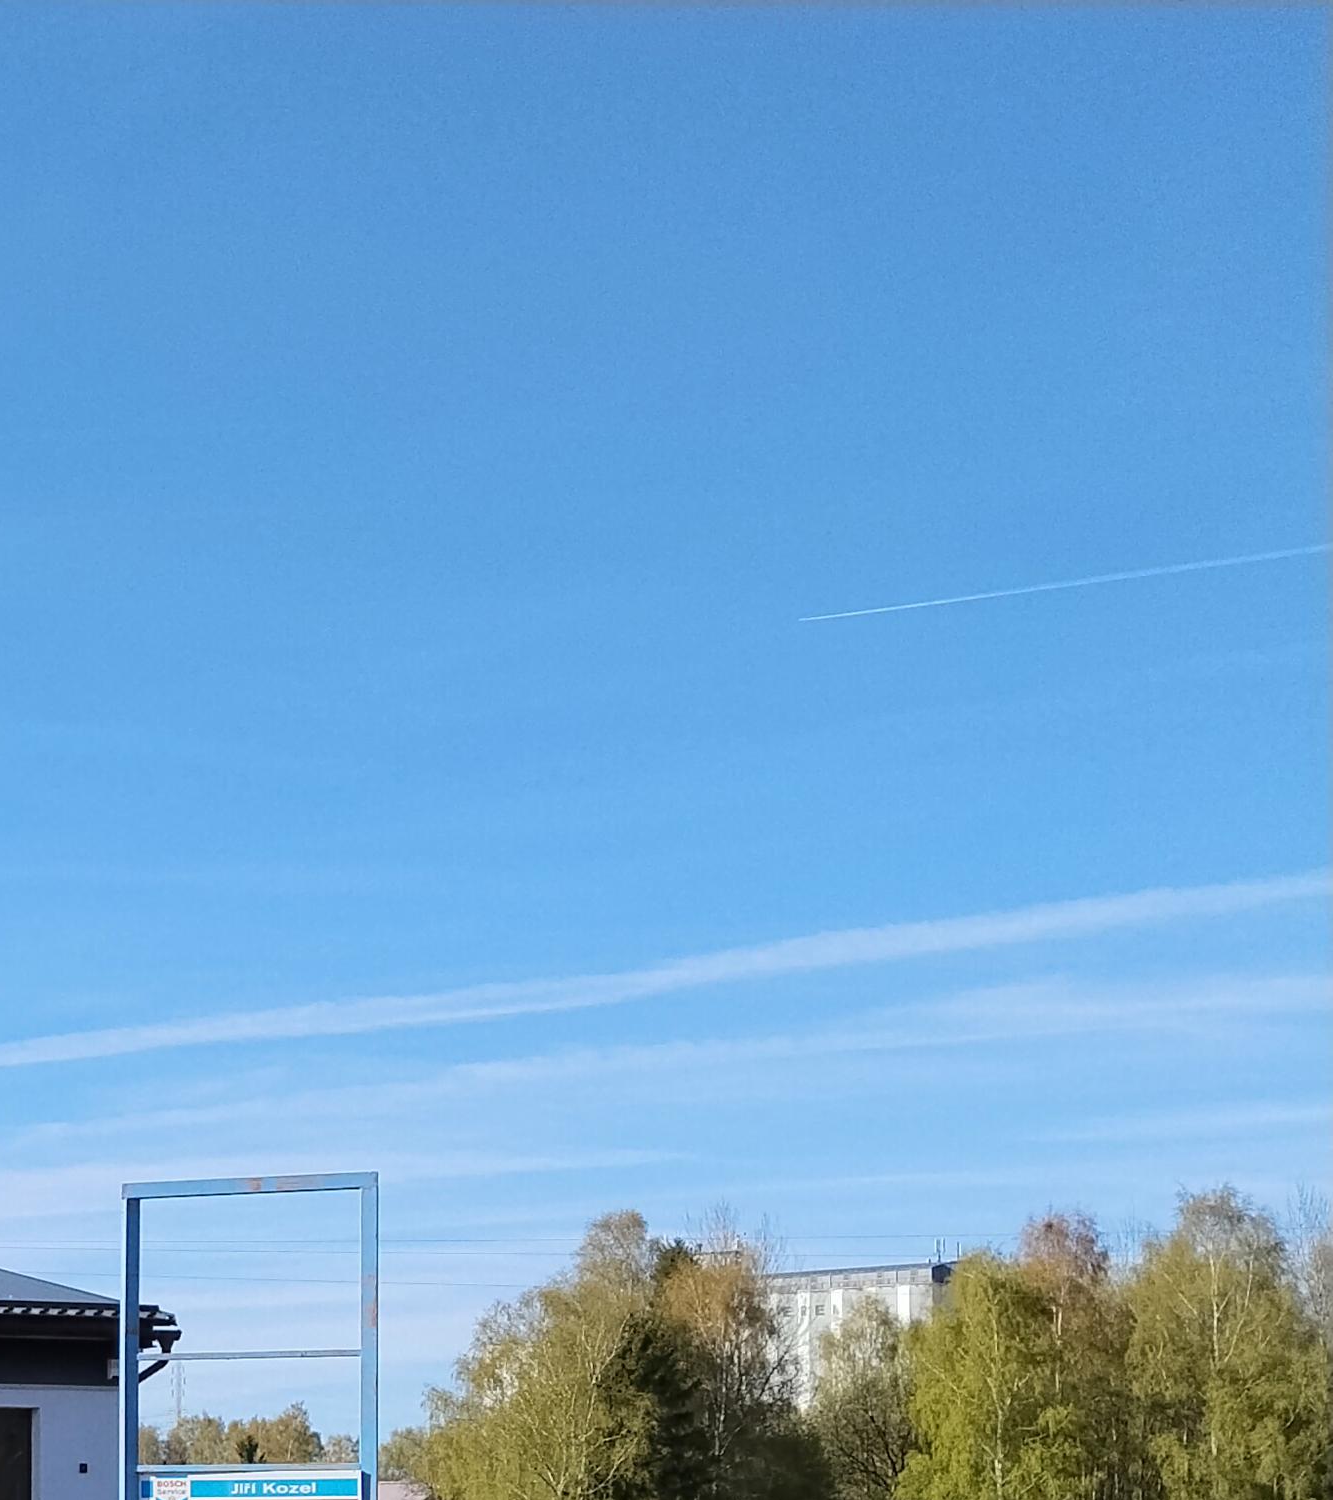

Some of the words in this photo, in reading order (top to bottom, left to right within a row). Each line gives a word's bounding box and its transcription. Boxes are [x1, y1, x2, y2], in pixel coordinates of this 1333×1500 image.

[156, 1480, 187, 1488] BOSCH
[230, 1481, 256, 1495] Jiří
[262, 1481, 317, 1495] Kozel
